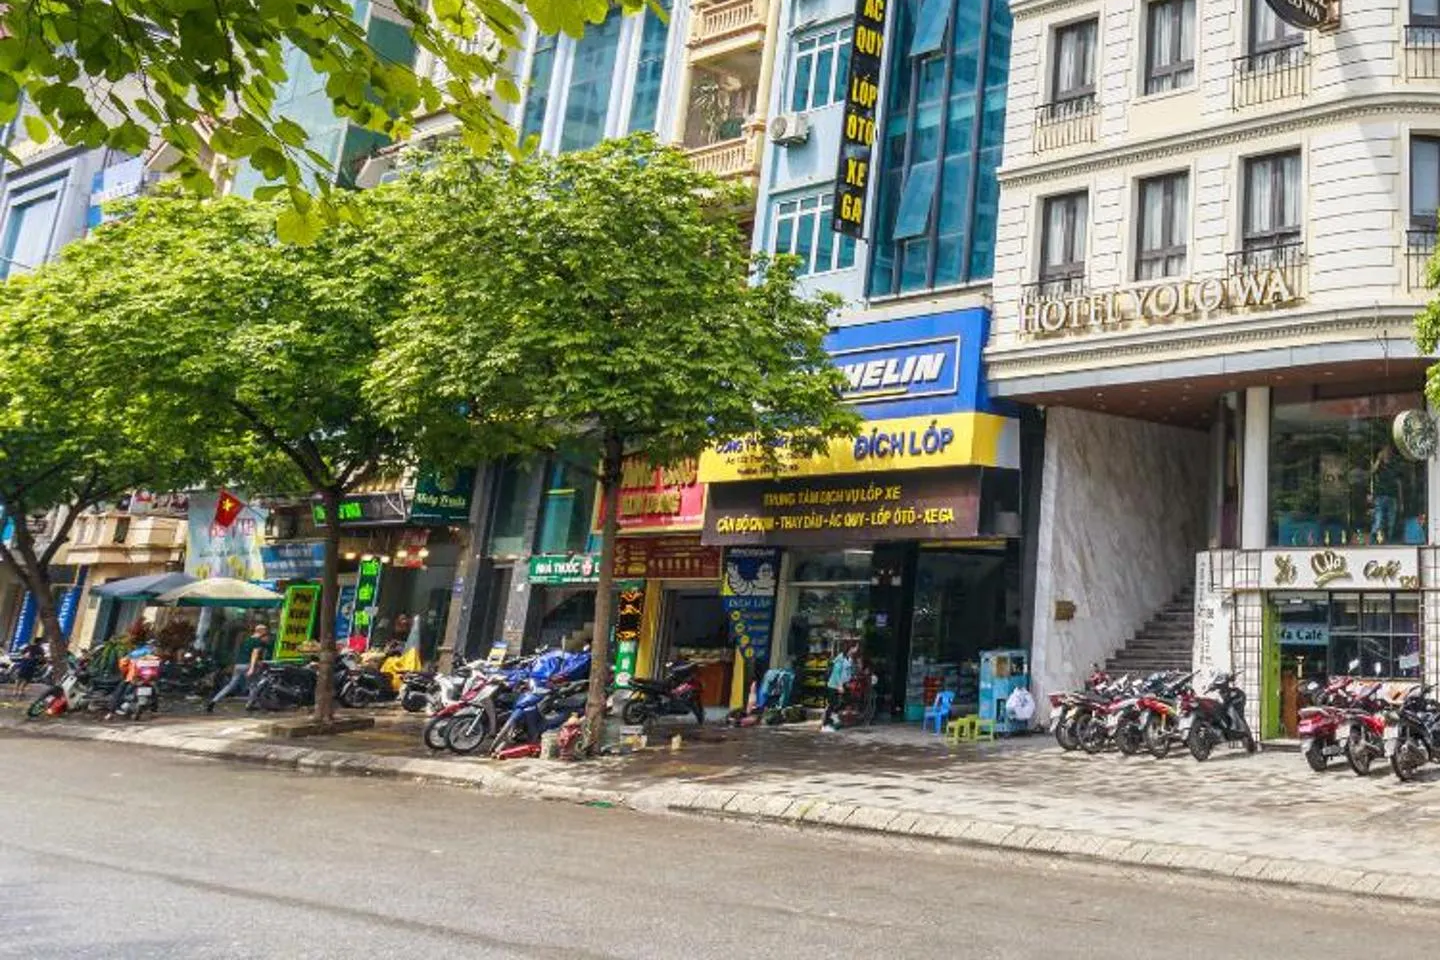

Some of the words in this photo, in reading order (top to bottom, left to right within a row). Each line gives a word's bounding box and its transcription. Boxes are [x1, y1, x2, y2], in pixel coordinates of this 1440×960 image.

[855, 25, 884, 57] QUY
[846, 158, 867, 187] XE
[841, 193, 862, 223] GA
[1019, 293, 1122, 333] HOTEL
[1132, 279, 1222, 319] YOLO
[1231, 269, 1291, 306] WA
[853, 428, 905, 460] ĐÍCH
[908, 419, 954, 456] LỐP
